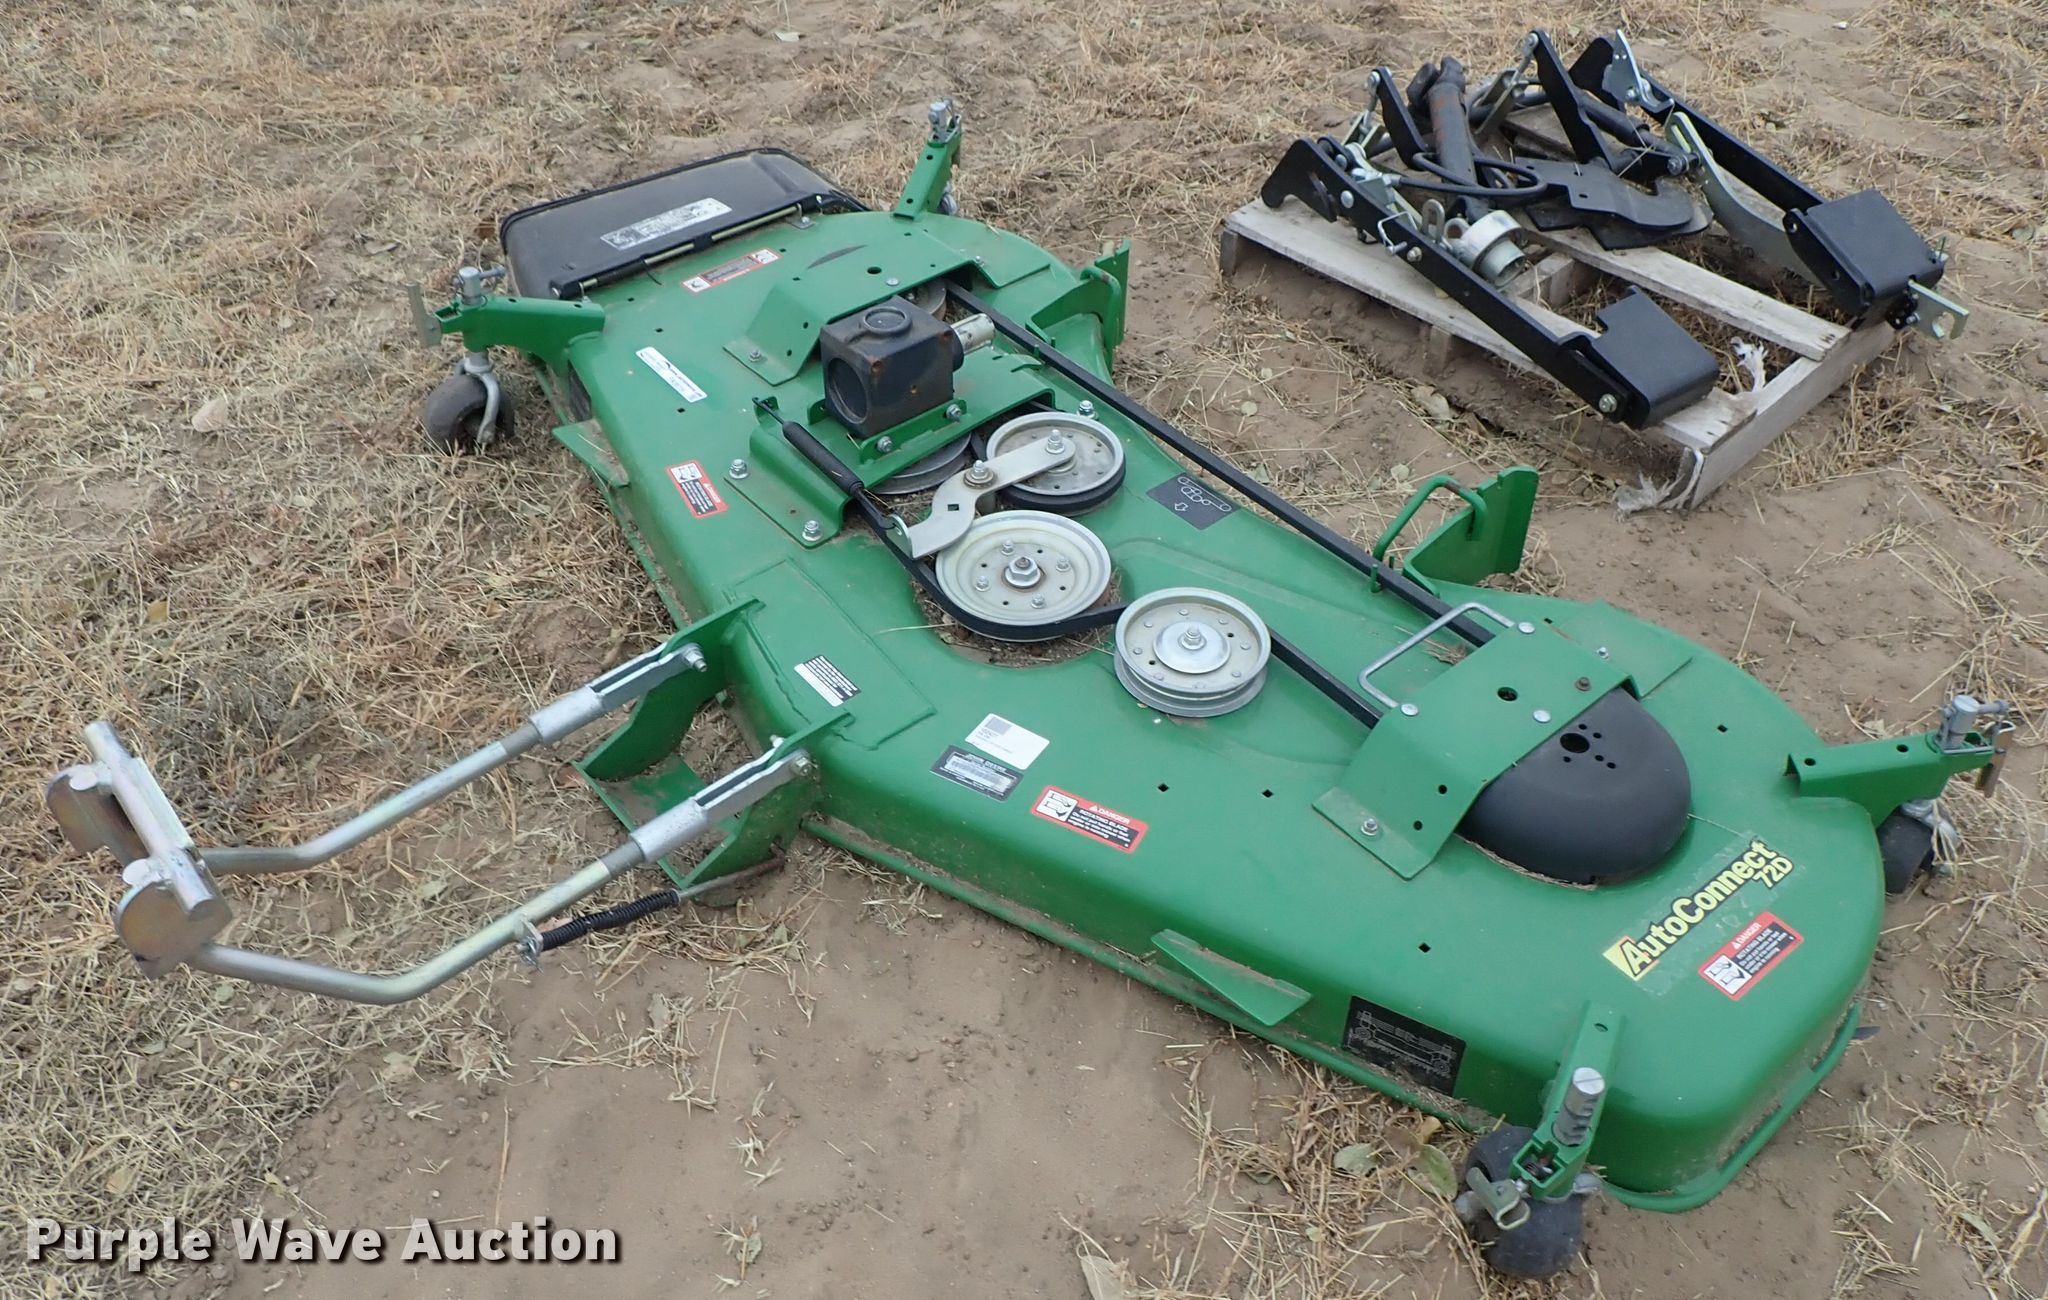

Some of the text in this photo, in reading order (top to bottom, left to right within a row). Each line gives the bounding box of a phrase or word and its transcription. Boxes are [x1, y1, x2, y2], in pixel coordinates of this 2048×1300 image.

[1096, 808, 1131, 824] DANGER
[1753, 856, 1793, 888] 72D
[1621, 841, 1777, 975] AutoConnect
[1735, 921, 1762, 944] DANGER
